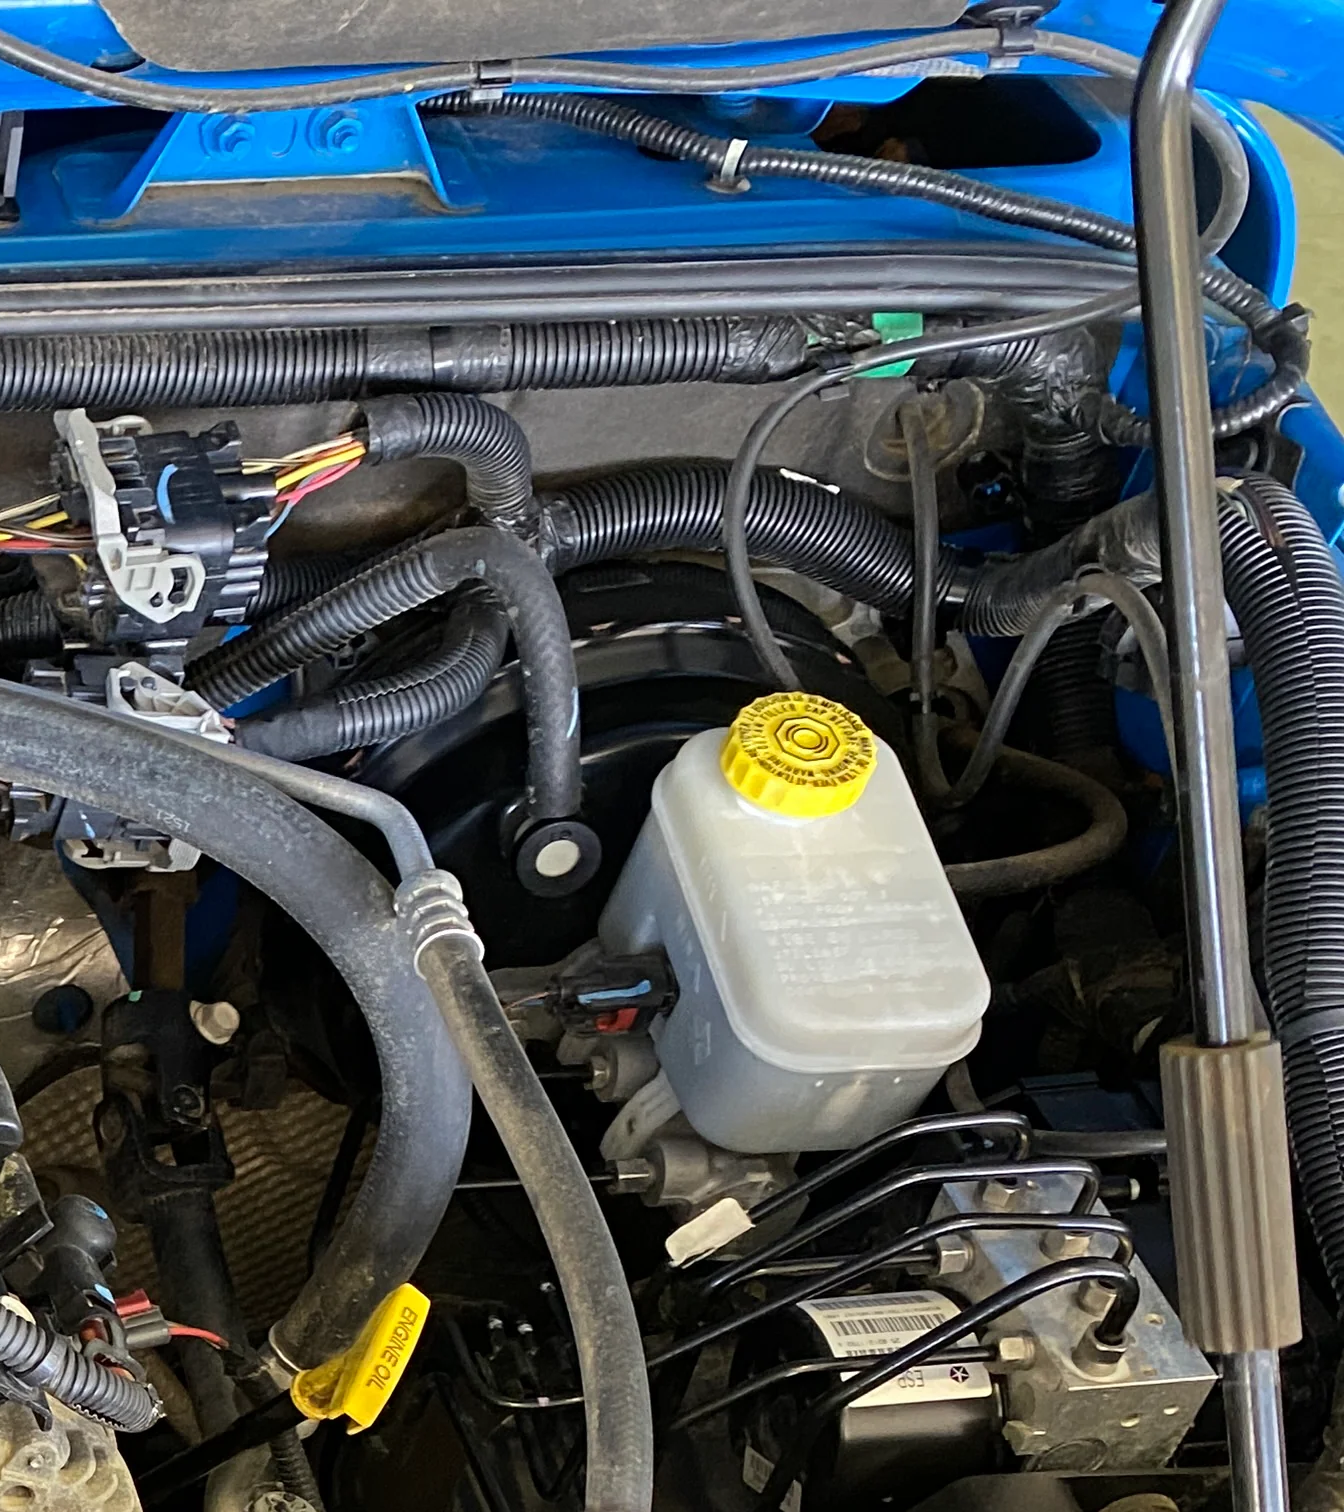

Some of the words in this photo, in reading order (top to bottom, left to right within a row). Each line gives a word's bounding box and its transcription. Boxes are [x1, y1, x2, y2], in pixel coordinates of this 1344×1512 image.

[804, 703, 828, 716] CAP
[380, 1306, 418, 1367] ENGINE
[366, 1364, 391, 1390] OIL
